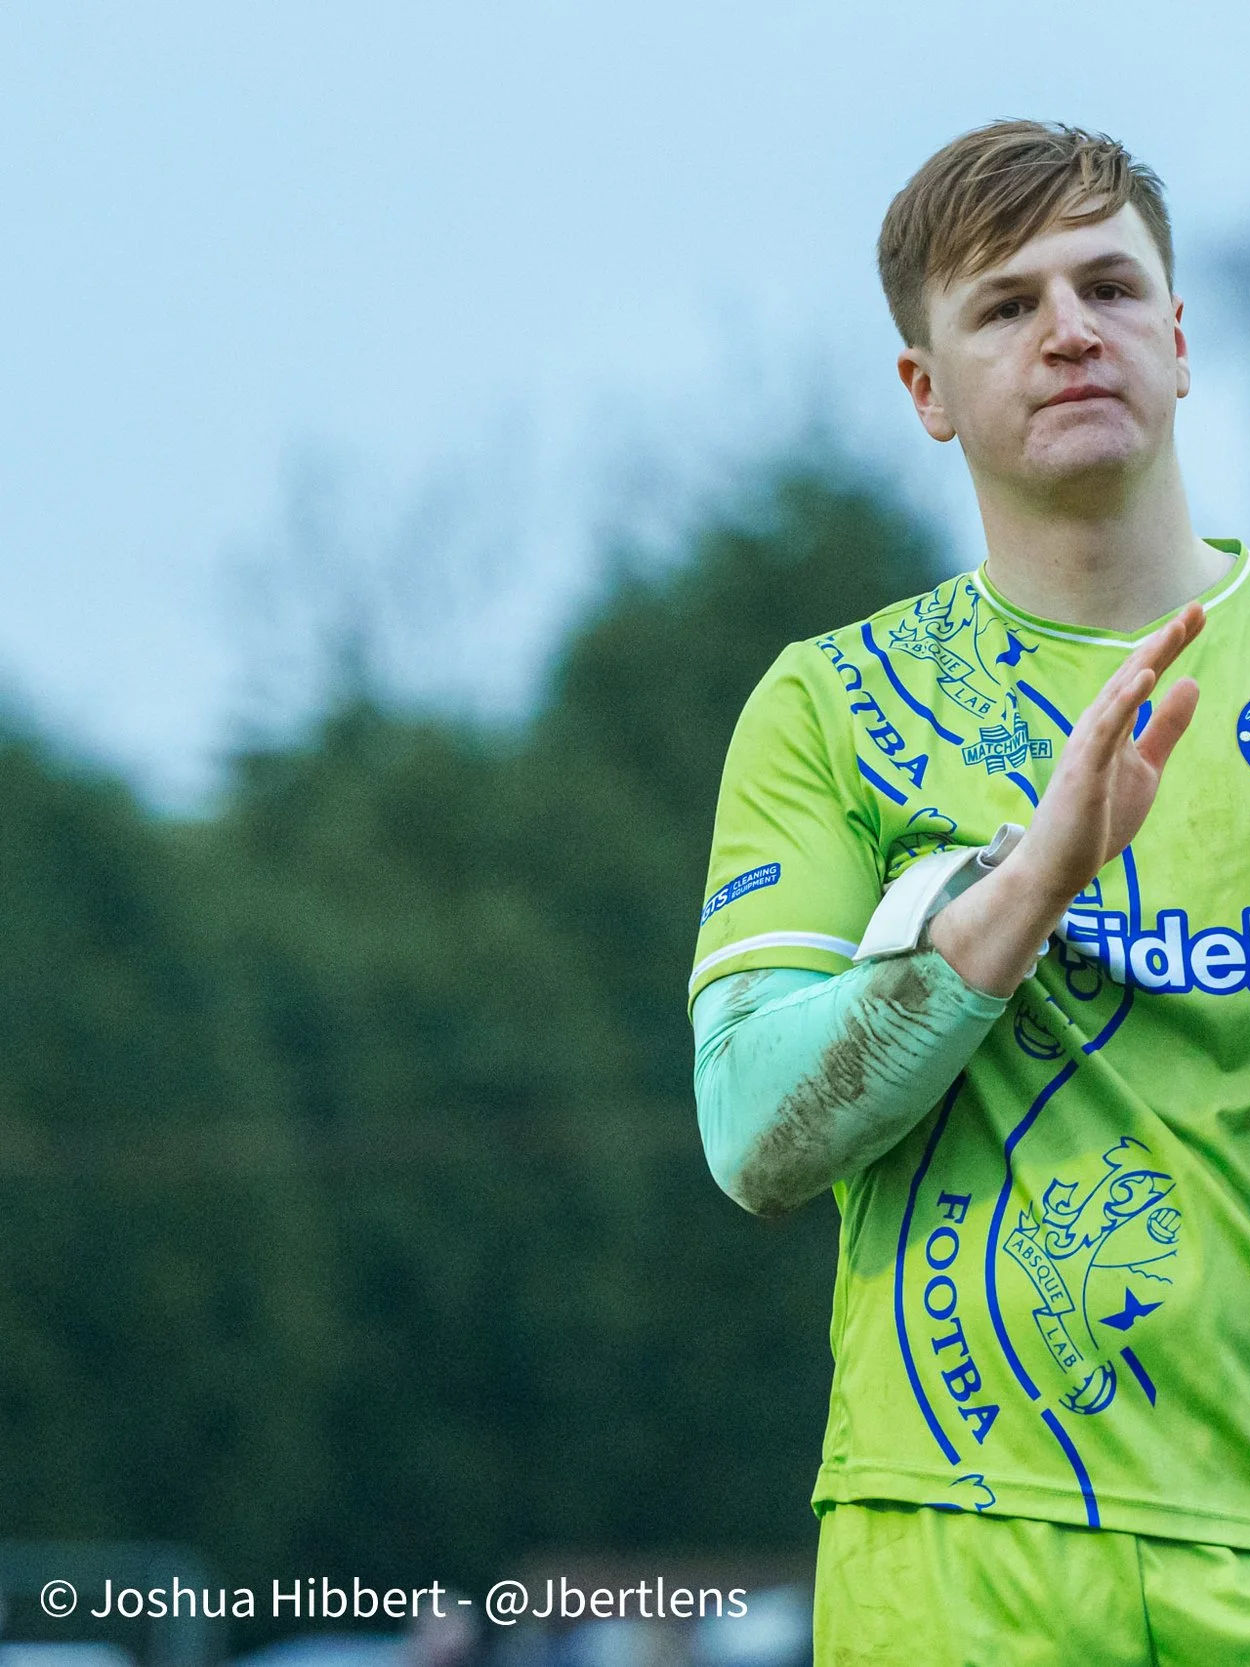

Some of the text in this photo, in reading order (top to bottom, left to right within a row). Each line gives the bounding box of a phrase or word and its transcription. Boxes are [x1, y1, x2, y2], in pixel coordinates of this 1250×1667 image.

[954, 688, 991, 714] LAB
[966, 730, 1049, 763] MATCHWIER
[731, 875, 777, 899] EQUIPMENT
[732, 866, 777, 891] CLEANING
[923, 1189, 1001, 1445] FOOTBA
[1011, 1238, 1077, 1368] ABSQUE LAB
